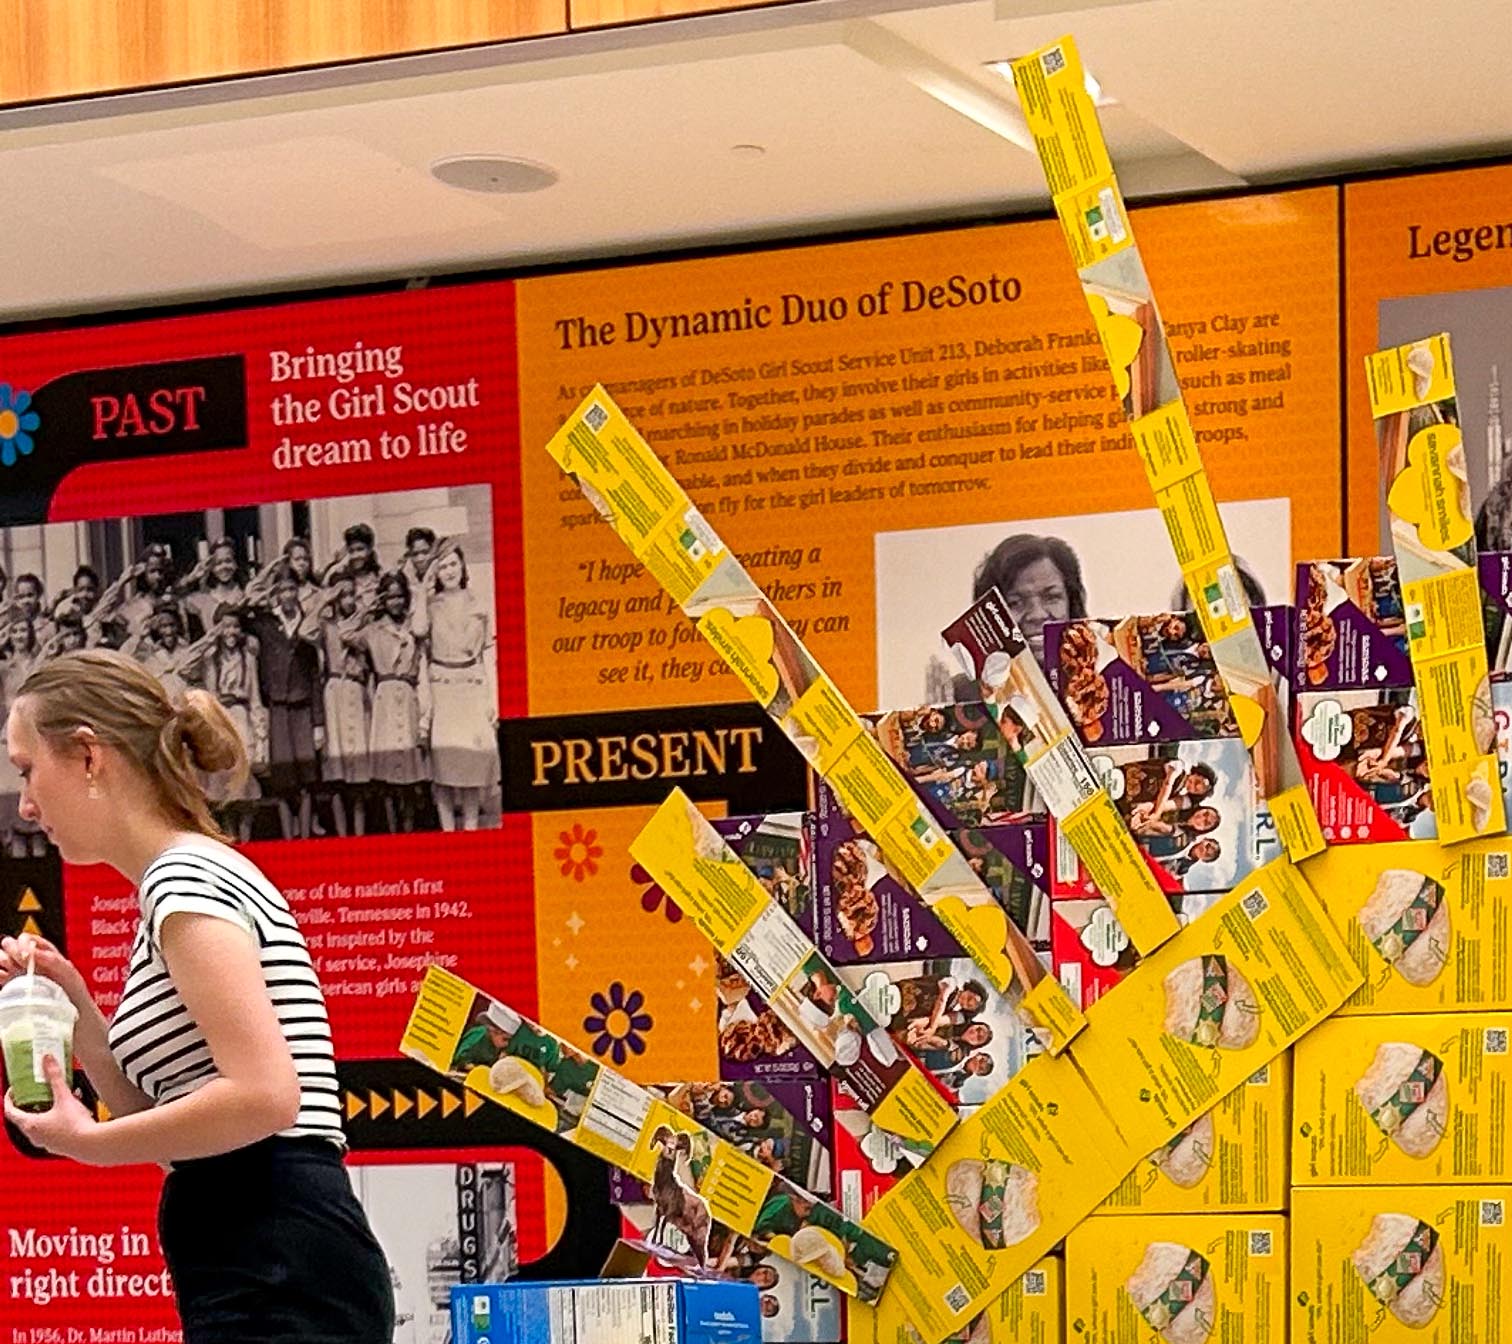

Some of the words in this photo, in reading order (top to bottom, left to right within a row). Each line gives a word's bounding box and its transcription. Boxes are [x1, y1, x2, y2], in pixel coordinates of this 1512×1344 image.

[556, 317, 615, 350] The
[625, 298, 771, 348] Dynamic
[782, 293, 847, 326] Duo
[858, 282, 894, 319] of
[902, 276, 1022, 312] DeSoto
[271, 341, 403, 383] Bringing
[759, 361, 788, 379] Girl
[792, 356, 834, 375] Scout
[838, 353, 896, 372] Service
[900, 348, 934, 365] Unit
[975, 334, 1042, 358] Deborah
[1211, 314, 1248, 339] Clay
[1252, 313, 1279, 329] are
[944, 368, 979, 390] girls
[1003, 358, 1077, 381] activities
[1176, 338, 1291, 364] roller-skating
[90, 387, 205, 441] PAST
[272, 395, 320, 426] the
[328, 386, 384, 421] Girl
[393, 378, 479, 413] Scout
[1251, 392, 1285, 411] and
[273, 438, 370, 470] dream
[381, 433, 410, 459] to
[418, 423, 468, 456] life
[1019, 442, 1054, 460] lead
[1058, 437, 1095, 455] their
[599, 560, 643, 587] hope
[558, 598, 619, 620] legacy
[625, 593, 662, 613] and
[822, 577, 842, 597] in
[552, 632, 585, 653] our
[592, 629, 643, 654] troop
[648, 627, 665, 646] to
[818, 614, 849, 633] can
[599, 665, 626, 684] see
[634, 661, 654, 682] it,
[661, 658, 704, 683] they
[531, 727, 763, 786] PRESENT
[413, 878, 443, 895] first
[434, 901, 472, 920] 1942,
[8, 1226, 115, 1264] Moving
[122, 1226, 150, 1256] in
[11, 1268, 80, 1305] right
[90, 1328, 135, 1343] Martin
